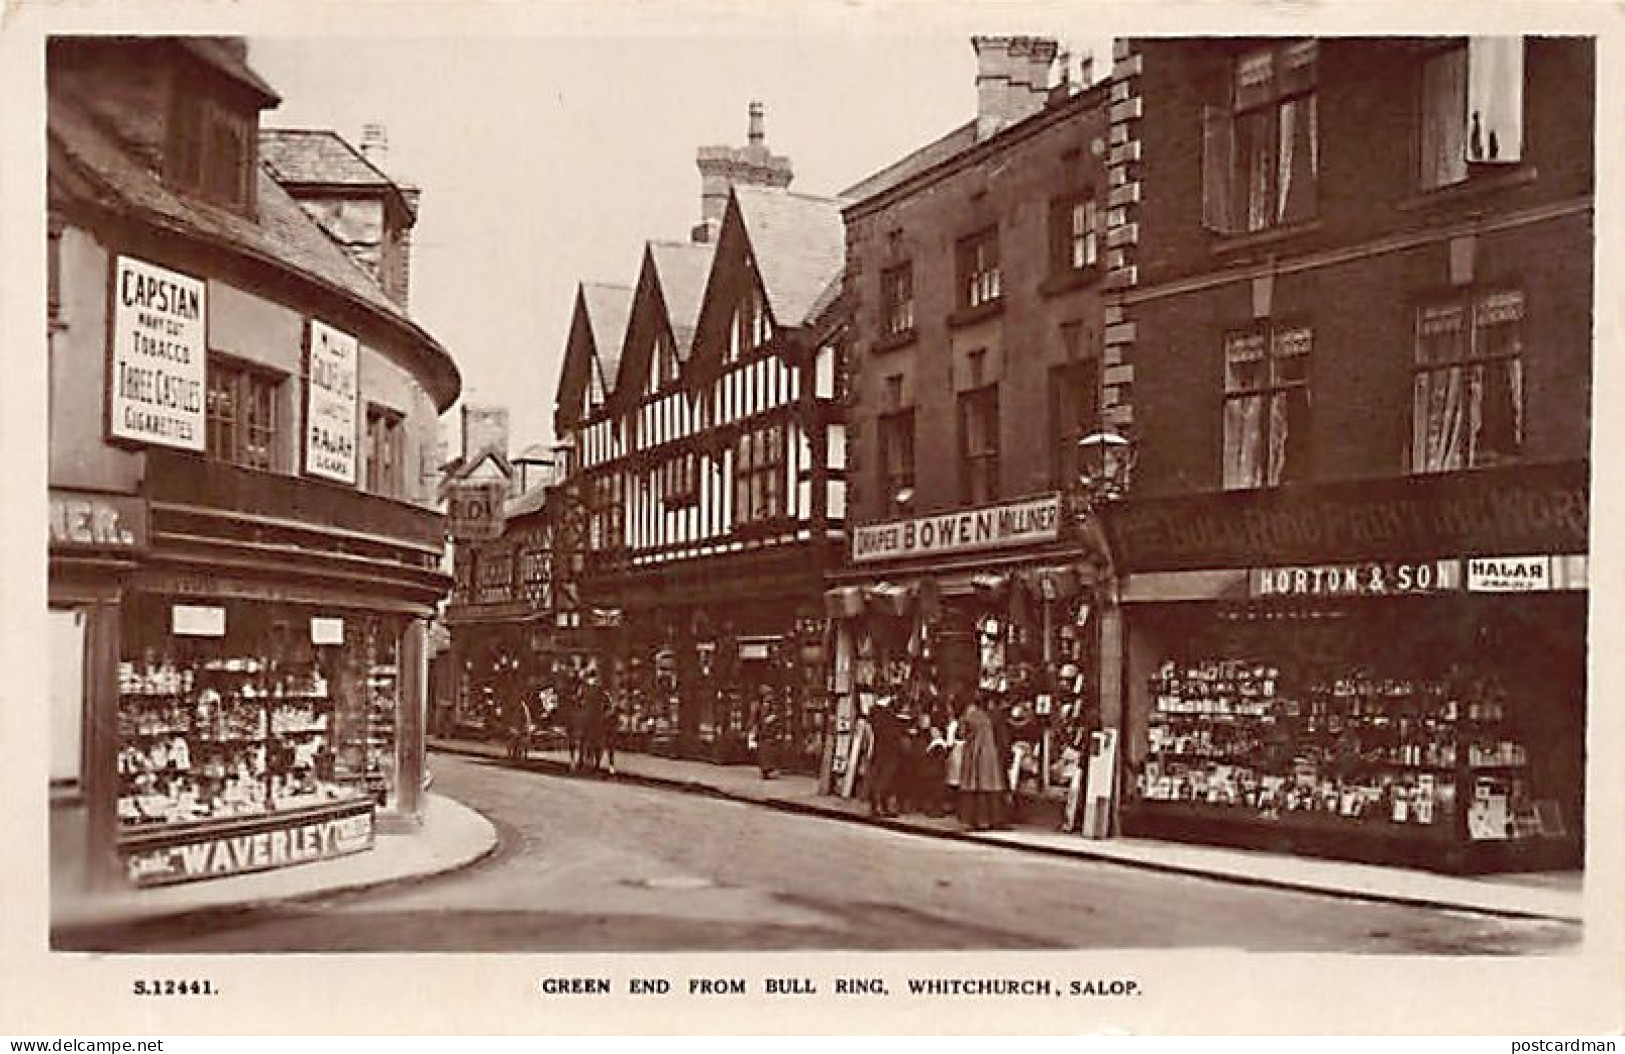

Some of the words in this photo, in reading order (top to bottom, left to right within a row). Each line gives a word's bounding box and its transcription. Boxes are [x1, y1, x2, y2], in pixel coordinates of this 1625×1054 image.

[122, 269, 199, 320] CAPSTAN
[133, 330, 190, 364] TOBACCO
[120, 360, 152, 404] THREE
[156, 369, 200, 414] CASTLES
[125, 405, 193, 441] CIGARETTES
[857, 529, 898, 556] DRAPER
[904, 511, 991, 549] BOWEN
[998, 504, 1057, 537] MILLINER
[1261, 565, 1357, 595] HORTON
[1369, 565, 1385, 590] &
[1399, 561, 1453, 590] SON
[182, 822, 332, 875] WAVERLEY
